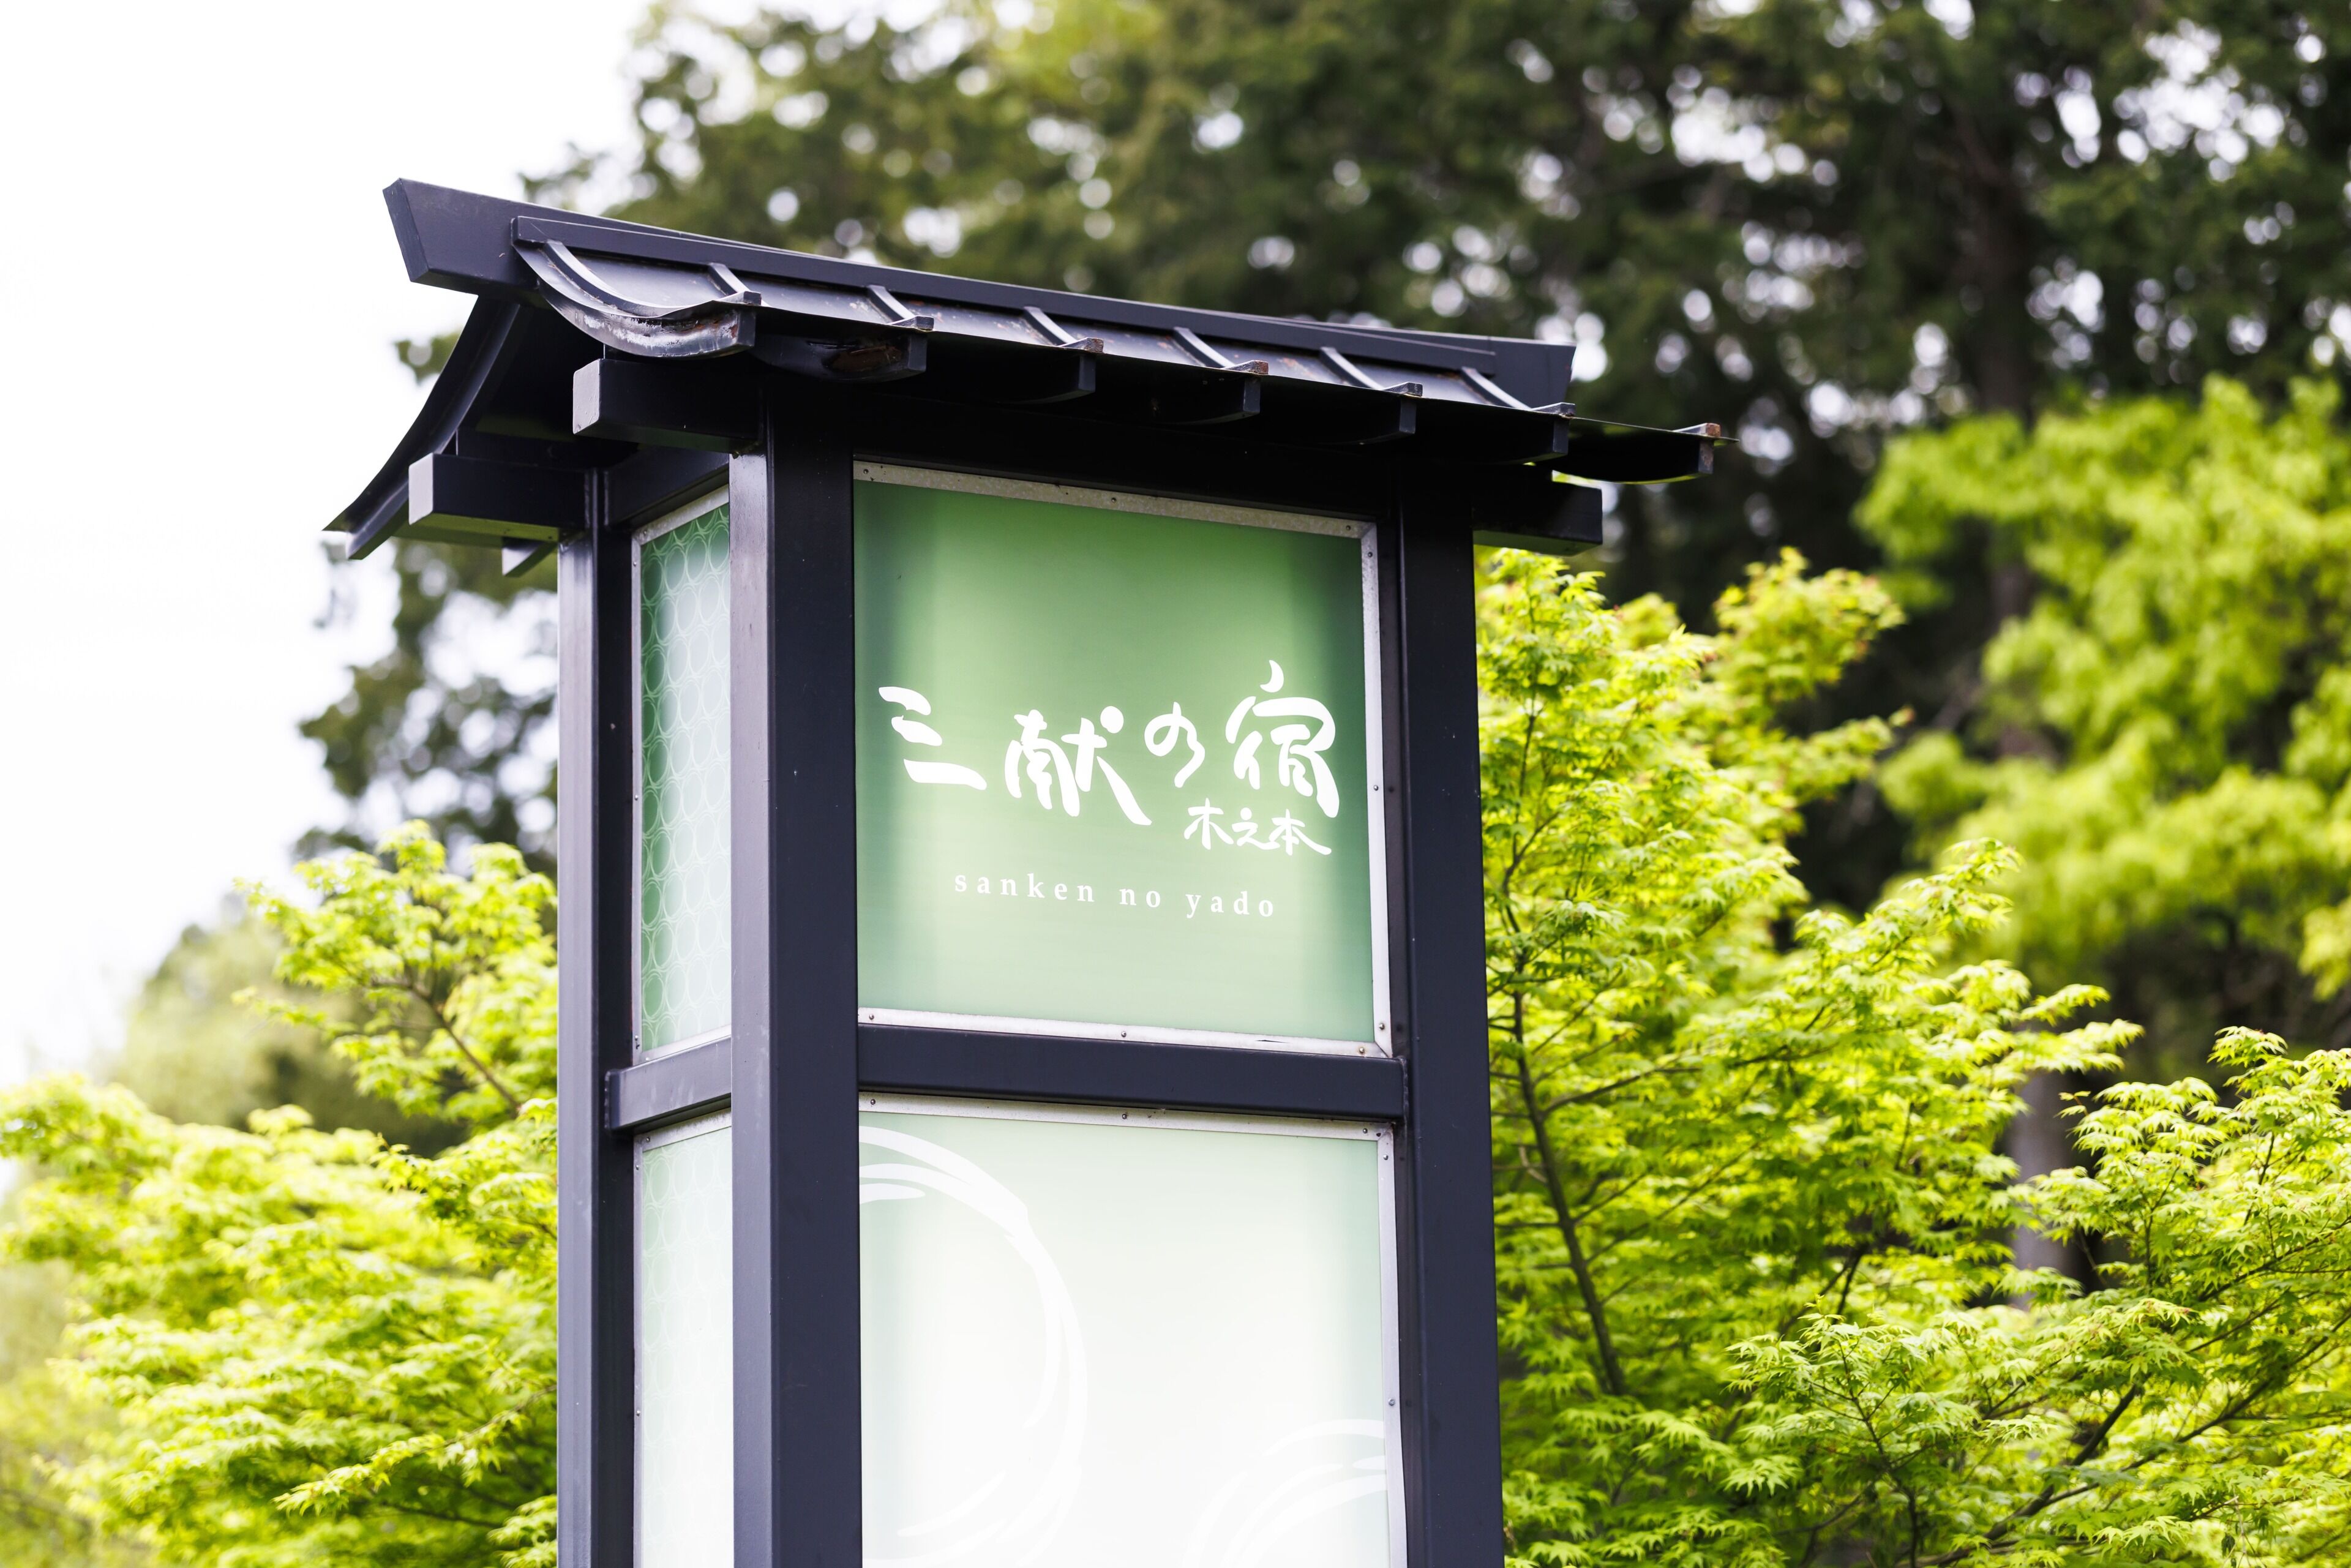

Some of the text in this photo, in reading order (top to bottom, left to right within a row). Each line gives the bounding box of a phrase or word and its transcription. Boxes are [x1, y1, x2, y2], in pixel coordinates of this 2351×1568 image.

[879, 660, 1339, 825] 三献の宿
[1184, 798, 1332, 855] 木之本
[954, 873, 1274, 919] sanken no yado
